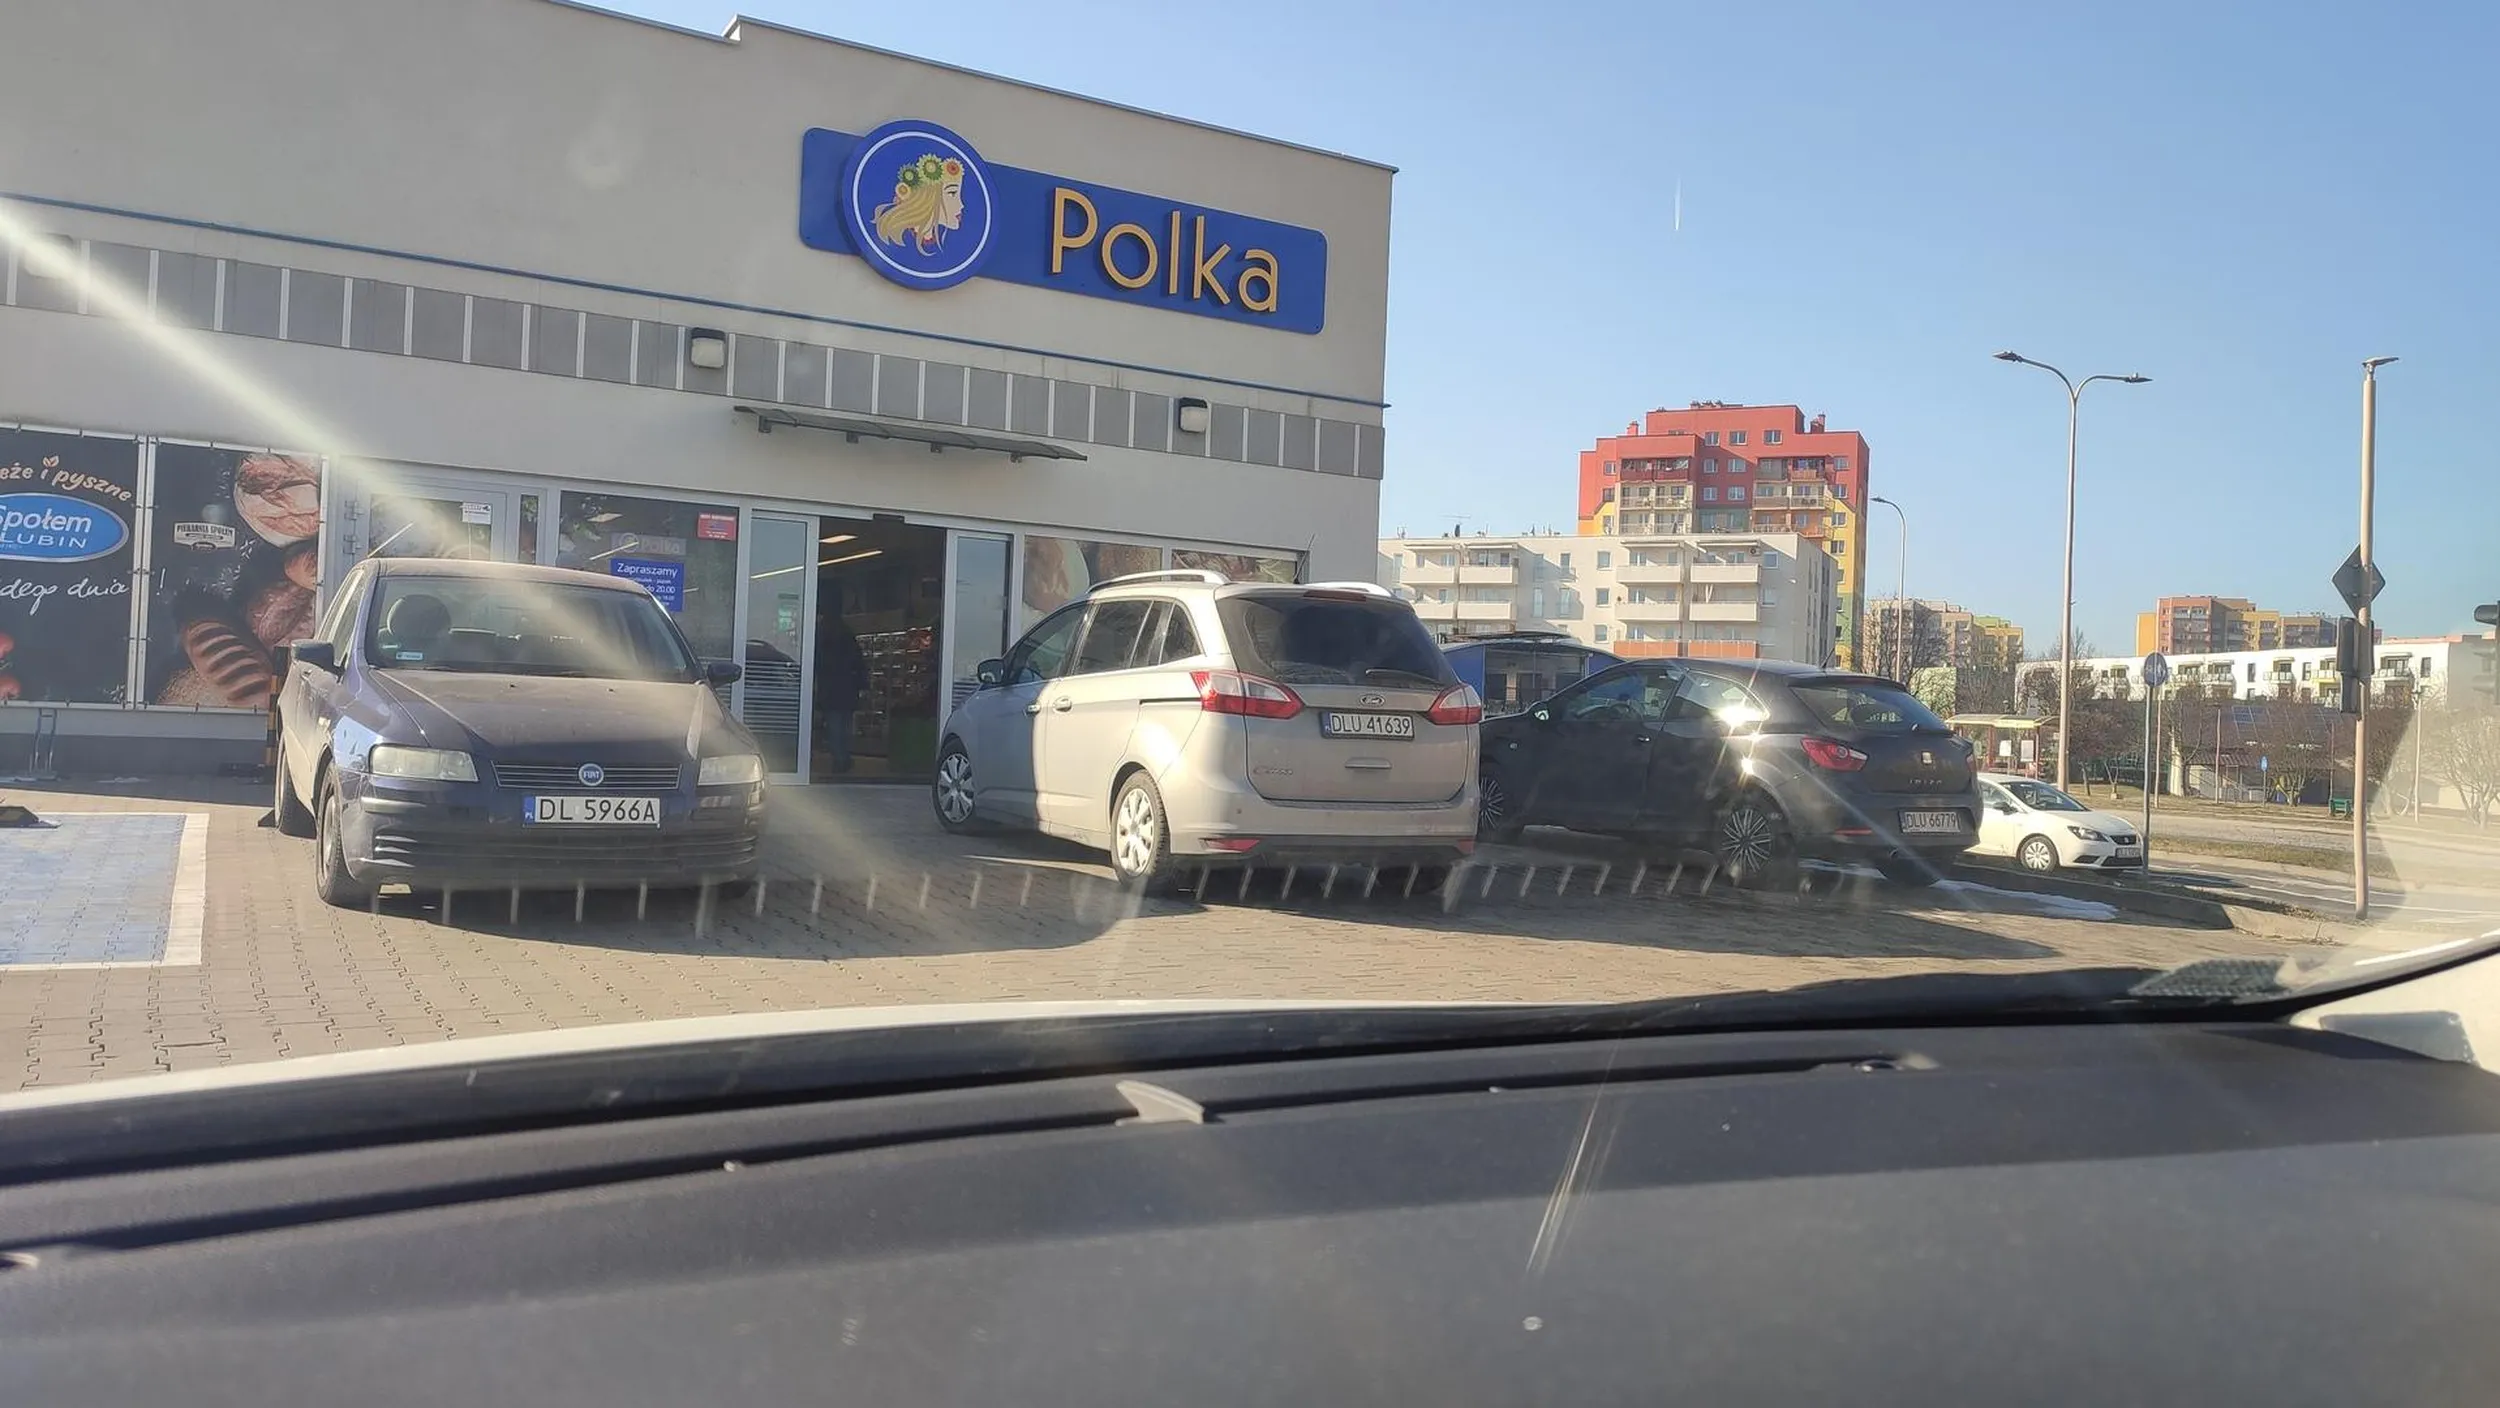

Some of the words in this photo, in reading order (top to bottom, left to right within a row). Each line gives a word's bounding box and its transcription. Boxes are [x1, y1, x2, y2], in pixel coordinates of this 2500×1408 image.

[1052, 187, 1279, 313] Polka
[51, 470, 132, 501] pyszne
[0, 531, 87, 549] LUBIN
[617, 562, 678, 578] Zapraszamy
[67, 577, 130, 599] dnia
[656, 584, 676, 594] 20.00
[1332, 715, 1361, 732] DLU
[1367, 716, 1410, 734] 41639
[583, 770, 600, 779] FIAT
[525, 811, 534, 819] PL
[540, 799, 573, 821] DL
[584, 799, 656, 821] 5966A
[1906, 813, 1927, 828] DLU
[1929, 813, 1956, 828] 66779
